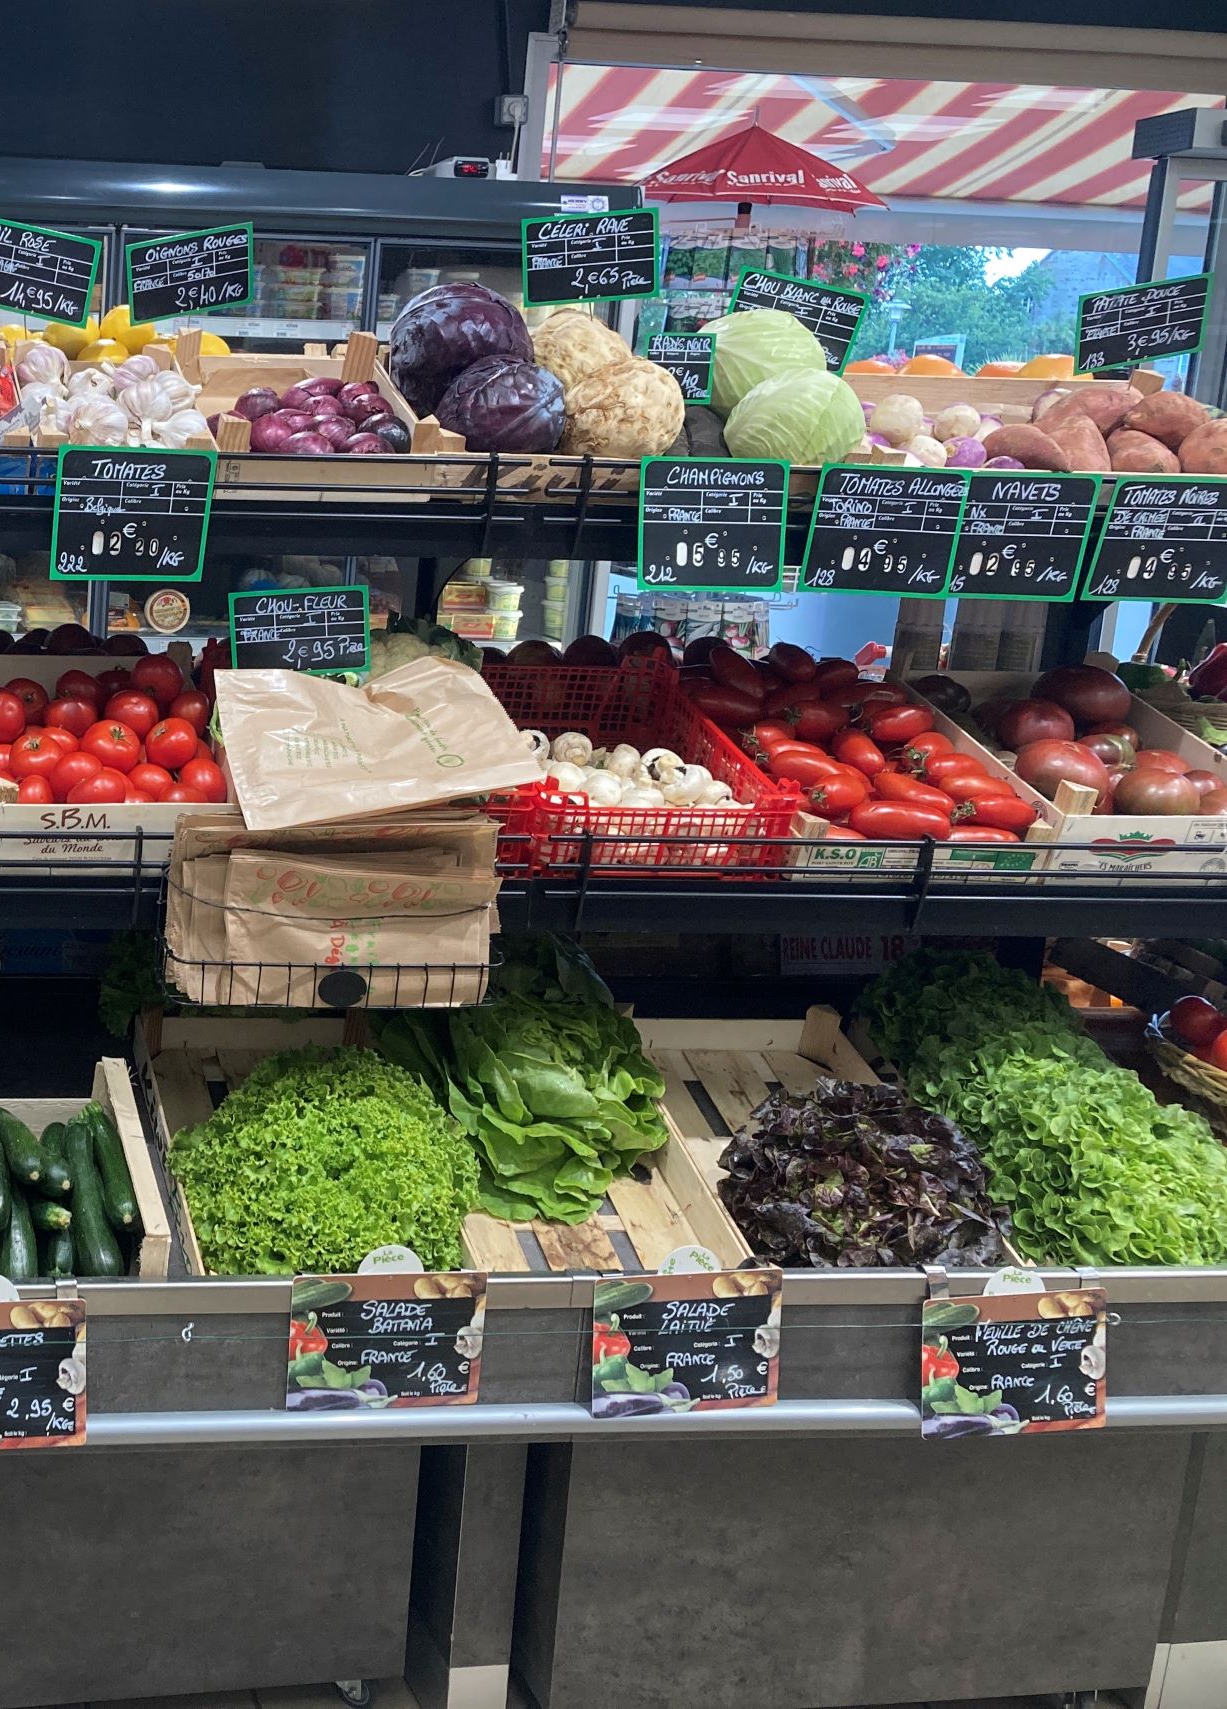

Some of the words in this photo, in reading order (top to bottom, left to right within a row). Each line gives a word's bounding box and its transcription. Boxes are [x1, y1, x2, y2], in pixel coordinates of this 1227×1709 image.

[727, 170, 805, 186] Sanrival
[596, 217, 633, 234] RAVE
[20, 232, 56, 251] ROSE
[204, 234, 248, 251] ROUGES
[743, 274, 781, 294] CHOU
[781, 283, 820, 303] BLANC
[831, 297, 864, 315] ROUGE
[1145, 285, 1186, 301] DOUCE
[1080, 352, 1105, 370] 133
[92, 459, 166, 480] TOMATES
[840, 474, 904, 495] TOMATES
[992, 482, 1062, 500] NAVETS
[1124, 485, 1177, 505] TOMATES
[58, 552, 87, 572] 222
[645, 565, 677, 583] 212
[805, 568, 835, 586] 128
[1089, 575, 1119, 594] 128
[41, 808, 111, 830] S.B.M.
[41, 846, 55, 854] du
[63, 844, 103, 853] Monde
[782, 936, 817, 960] REINE
[821, 936, 872, 960] CLAUDE
[373, 1253, 404, 1264] Pièce
[361, 1301, 432, 1319] SALADE
[662, 1302, 735, 1319] SALADE
[1027, 1324, 1048, 1338] DE
[986, 1340, 1028, 1356] ROUGE
[1051, 1337, 1086, 1352] VERTE
[360, 1350, 418, 1365] FRANCE
[666, 1352, 716, 1367] FRANCE
[991, 1374, 1035, 1389] FRANCE
